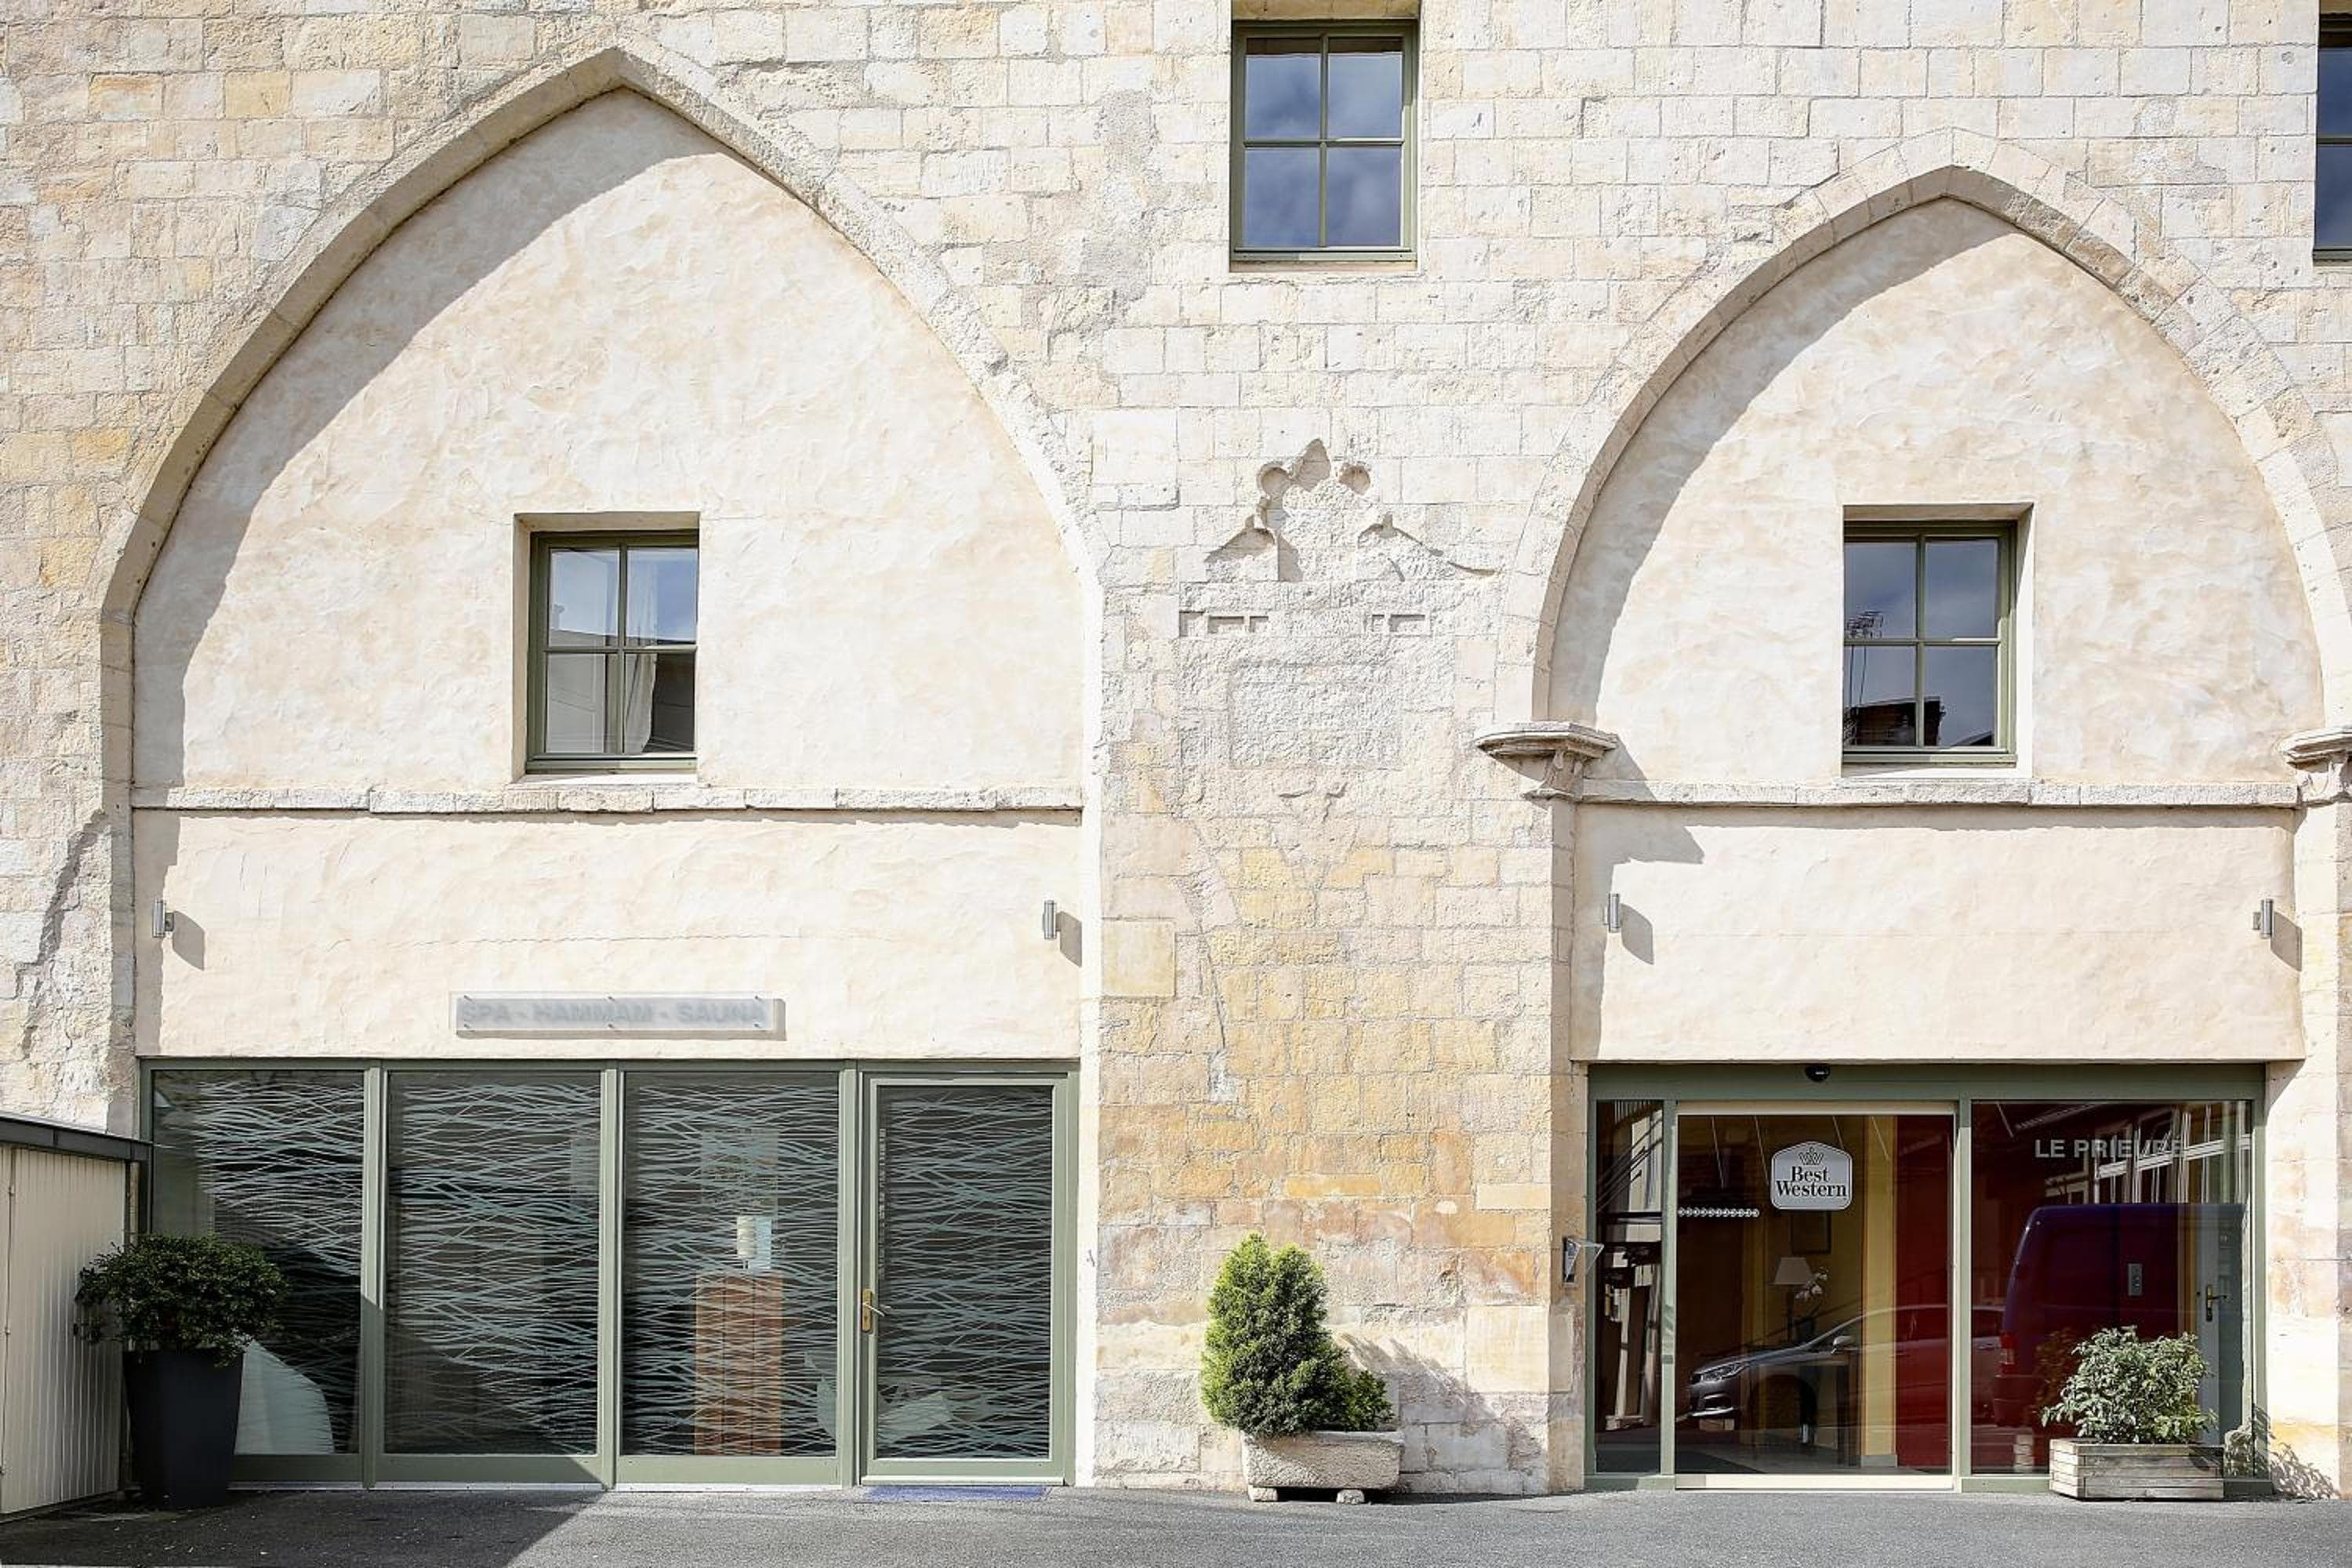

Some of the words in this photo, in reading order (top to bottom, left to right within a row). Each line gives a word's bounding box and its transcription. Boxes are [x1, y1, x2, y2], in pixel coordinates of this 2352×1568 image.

[463, 1002, 511, 1022] SPA
[534, 1002, 653, 1023] HAMMAM
[676, 1002, 765, 1022] SAUNA
[2034, 1139, 2066, 1159] LE
[1791, 1166, 1830, 1182] Best
[1776, 1181, 1846, 1197] Western
